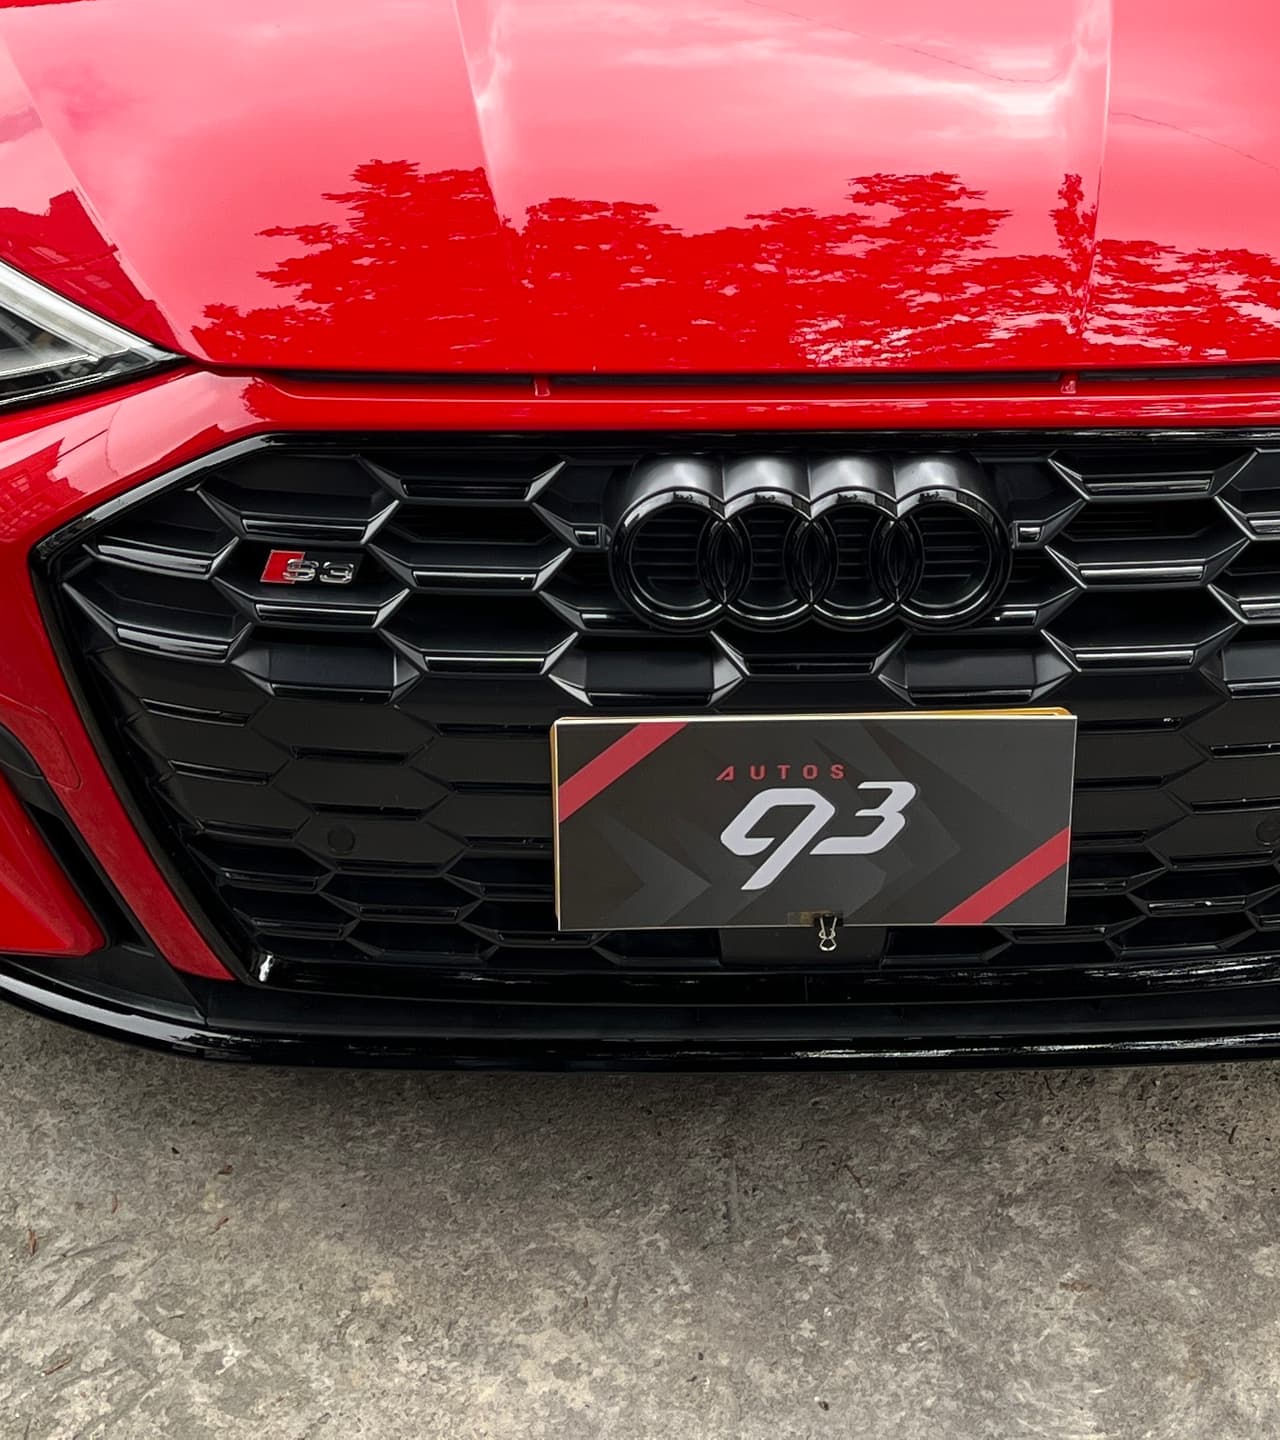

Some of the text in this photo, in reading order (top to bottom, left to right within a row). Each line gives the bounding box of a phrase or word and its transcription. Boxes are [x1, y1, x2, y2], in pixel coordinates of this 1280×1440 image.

[282, 558, 355, 585] S3
[716, 763, 845, 781] AUTOS
[720, 777, 917, 891] 93
